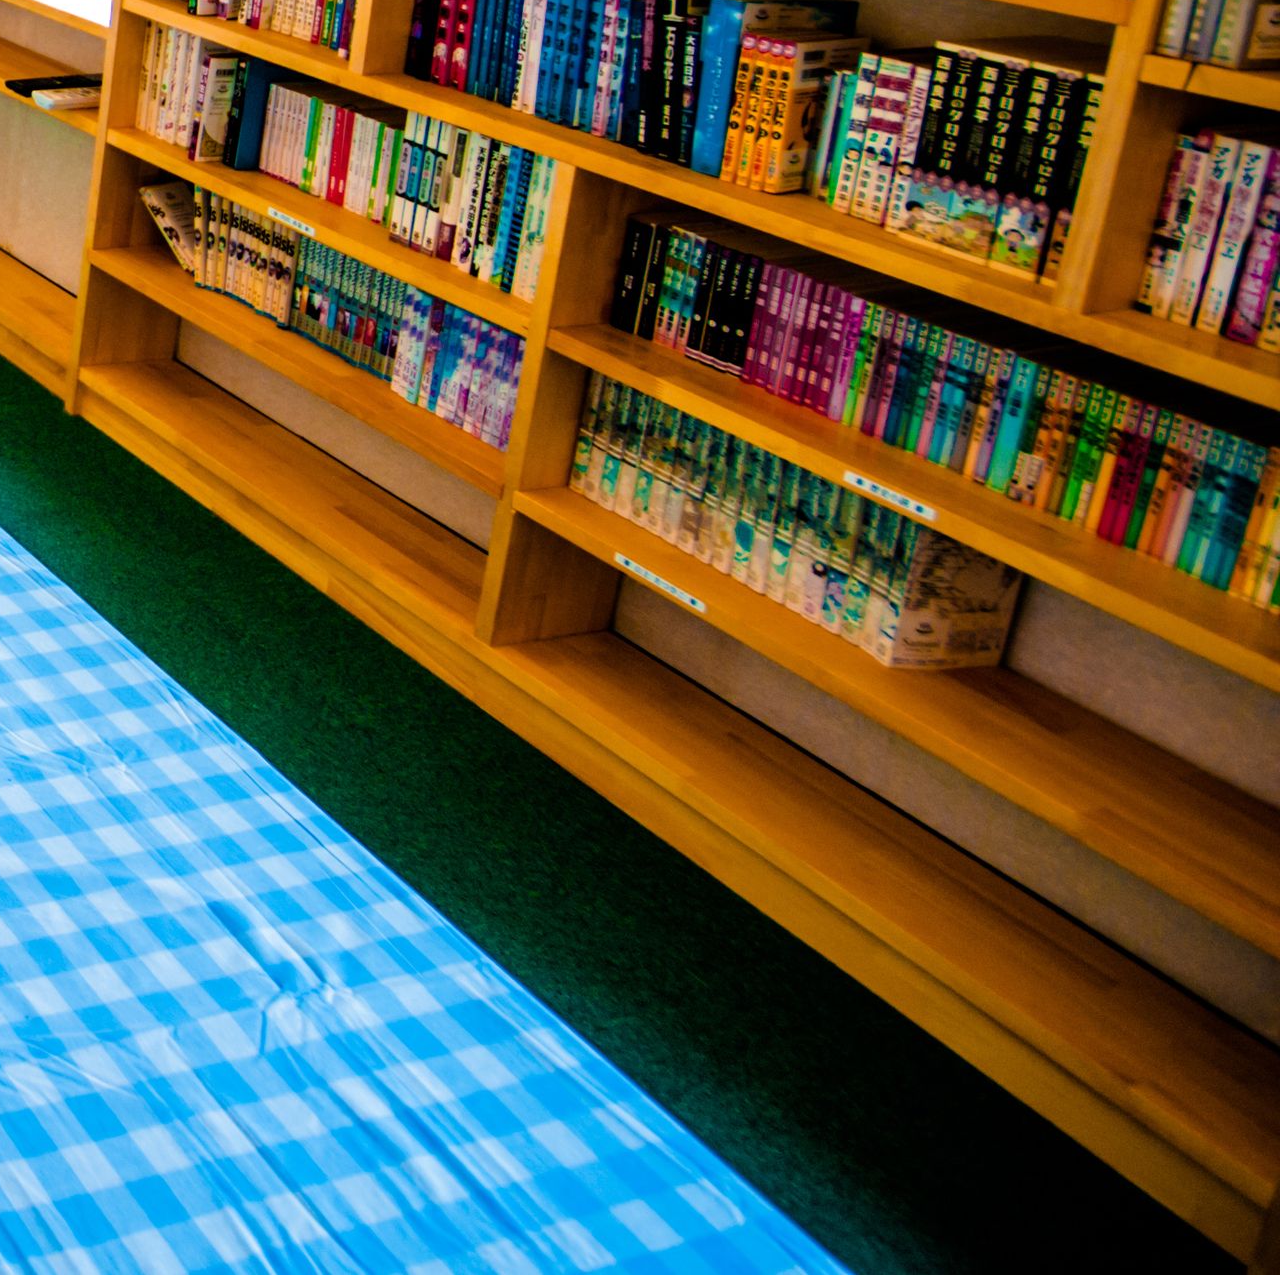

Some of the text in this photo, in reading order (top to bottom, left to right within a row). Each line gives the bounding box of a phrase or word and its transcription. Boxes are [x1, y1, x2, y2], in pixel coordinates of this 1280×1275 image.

[929, 55, 953, 111] 西岸良平
[973, 65, 1000, 123] 西岸良平
[1023, 75, 1051, 134] 西岸良平
